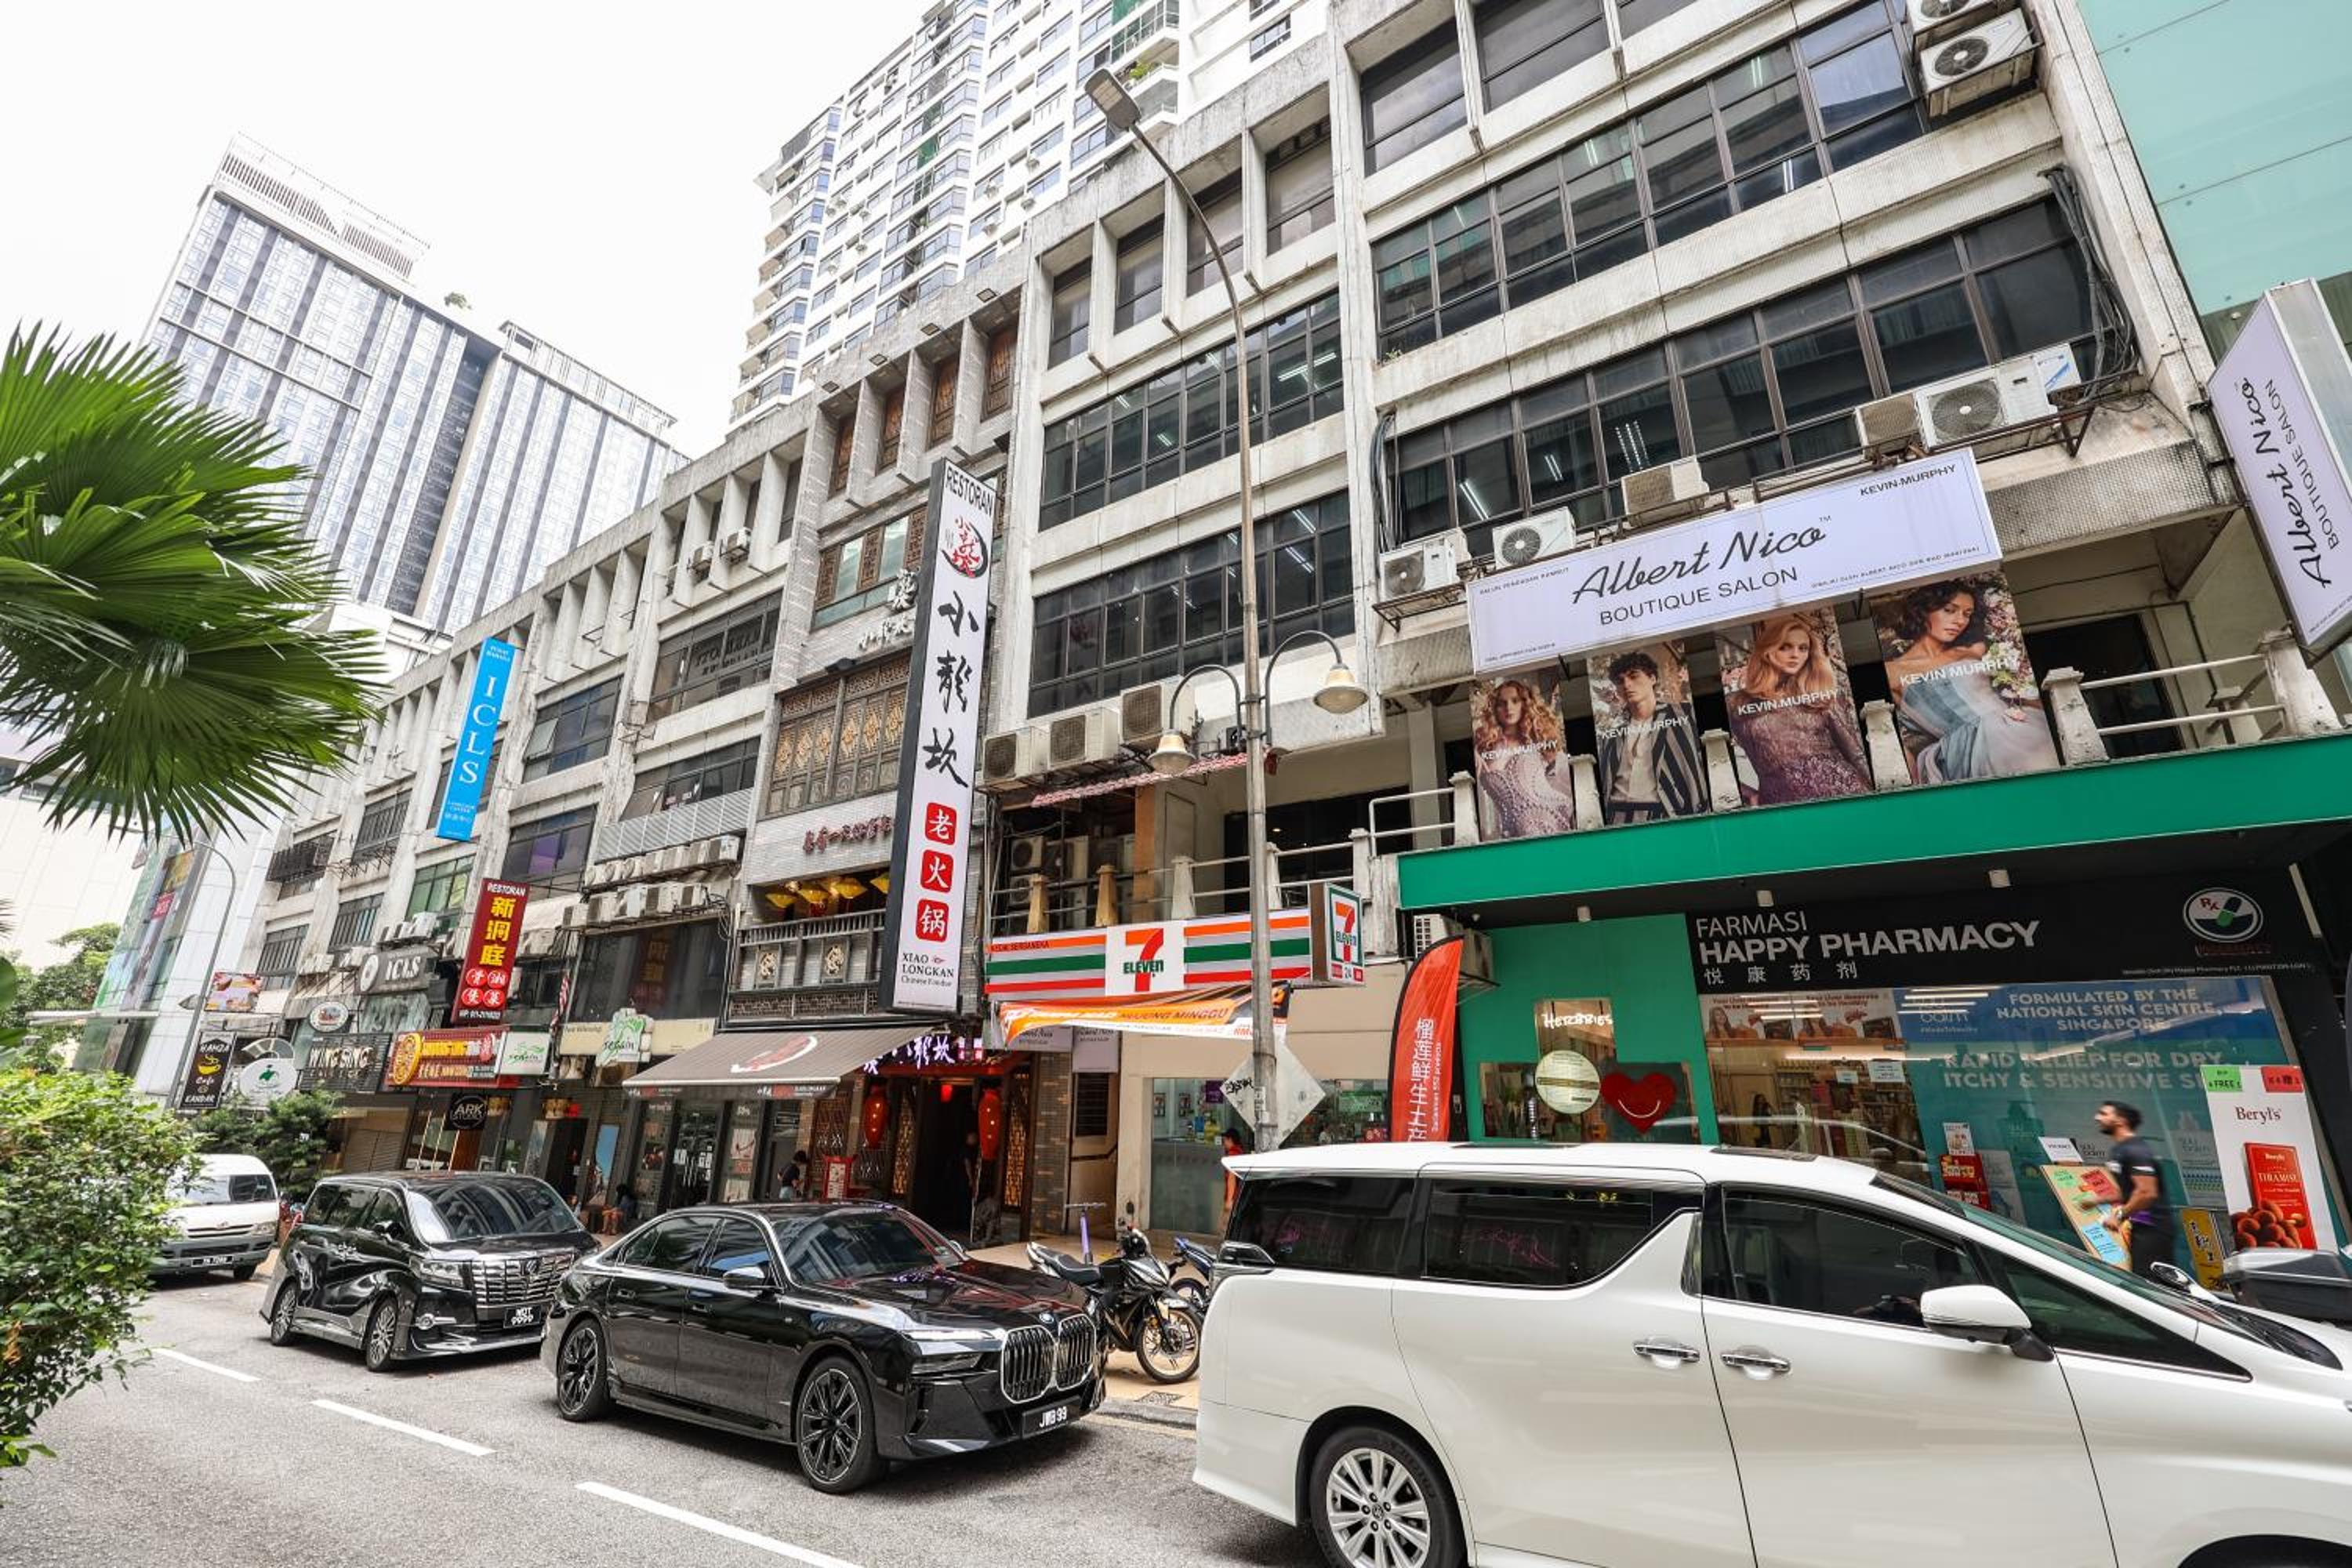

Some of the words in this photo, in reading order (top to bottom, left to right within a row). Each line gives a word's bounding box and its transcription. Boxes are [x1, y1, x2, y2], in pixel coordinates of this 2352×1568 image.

[2241, 378, 2280, 455] Nico
[2266, 379, 2299, 445] SALON
[946, 466, 994, 516] RESTORAN
[1860, 464, 1956, 495] KEVIN.MURPHY
[2292, 449, 2339, 550] BOUTIQUE
[2267, 463, 2332, 589] Albert
[1572, 541, 1711, 604] Albert
[1719, 526, 1826, 571] Nico
[1599, 586, 1711, 626] BOUTIQUE
[1718, 566, 1798, 598] SALON
[920, 809, 954, 937] 老火锅
[487, 883, 526, 897] RESTORAN
[479, 896, 517, 967] 新洞庭
[1335, 902, 1356, 962] 7
[1697, 911, 1808, 938] FARMASI
[1700, 935, 1809, 965] HAPPY
[1819, 920, 2040, 958] PHARMACY
[385, 956, 421, 980] ICLS
[902, 953, 929, 964] XIAO
[902, 964, 954, 978] LONGKAN
[1126, 928, 1164, 992] 7
[1704, 960, 1857, 986] 悦康药剂
[1997, 1004, 2089, 1018] NATIONAL
[2092, 1004, 2137, 1018] SKIN
[2009, 989, 2130, 1006] FORMULATED
[2135, 989, 2157, 1002] BY
[2160, 988, 2198, 1001] THE
[1174, 1008, 1229, 1019] MINGGU
[1944, 1052, 2016, 1069] RAPID
[2109, 1051, 2161, 1068] FOR
[1944, 1072, 2009, 1089] ITCHY
[2019, 1071, 2038, 1088] &
[2042, 1072, 2177, 1089] SENSITIVE
[2235, 1106, 2282, 1124] Beryl's
